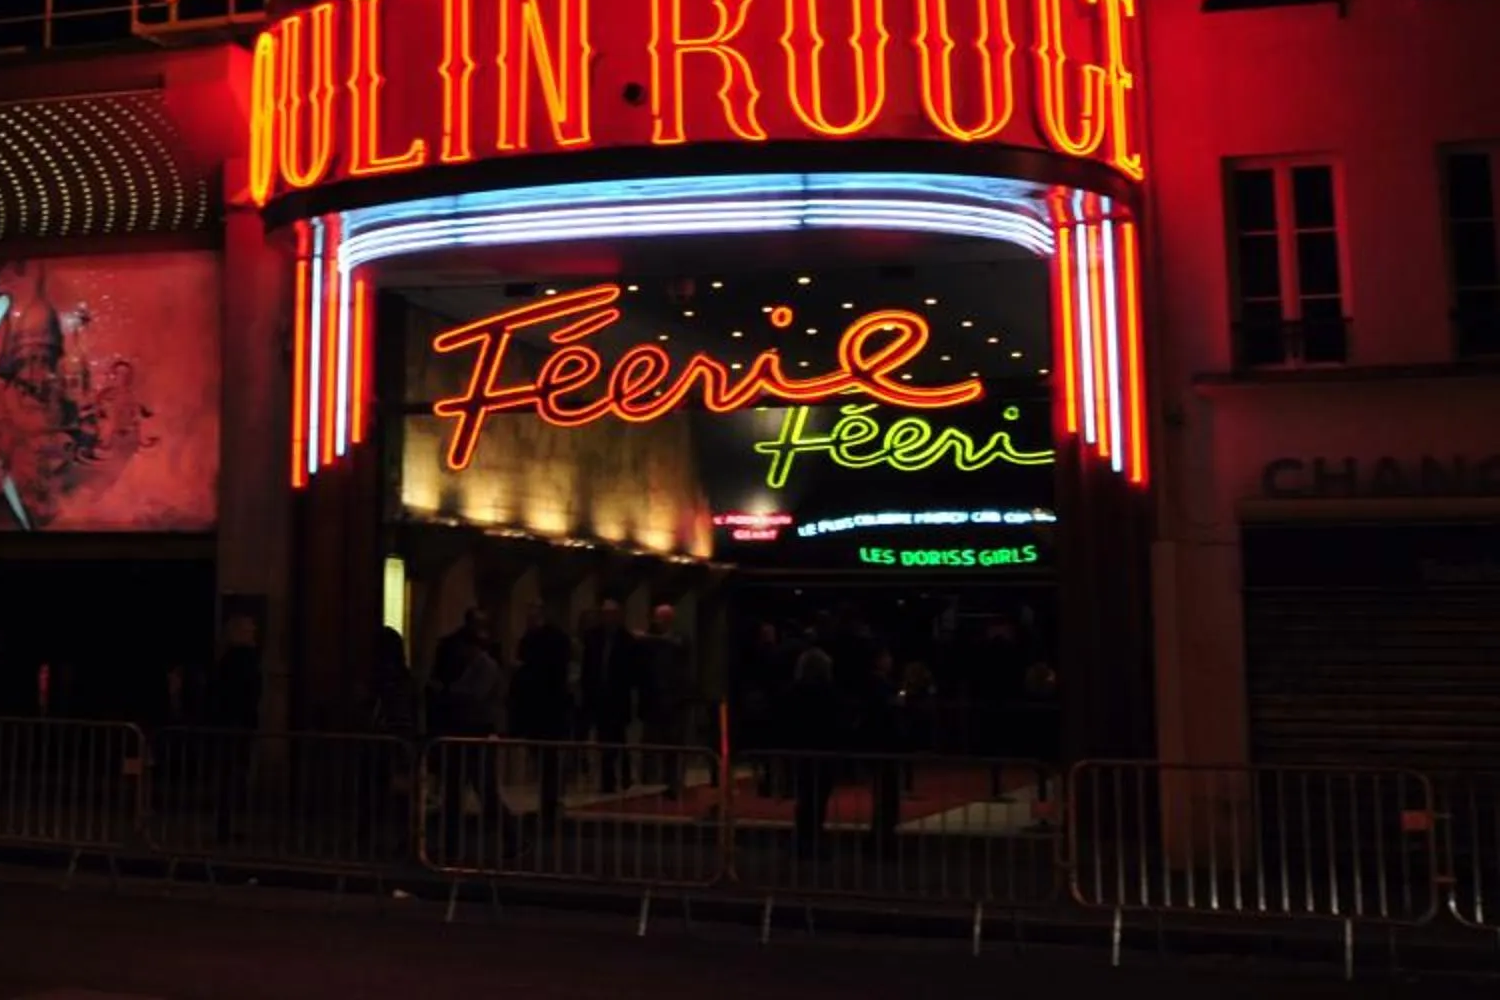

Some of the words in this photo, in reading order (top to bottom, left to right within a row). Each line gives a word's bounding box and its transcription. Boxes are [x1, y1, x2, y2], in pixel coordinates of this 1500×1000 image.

[860, 547, 895, 564] LES
[901, 549, 976, 566] DORISS
[979, 545, 1038, 566] GIRLS
